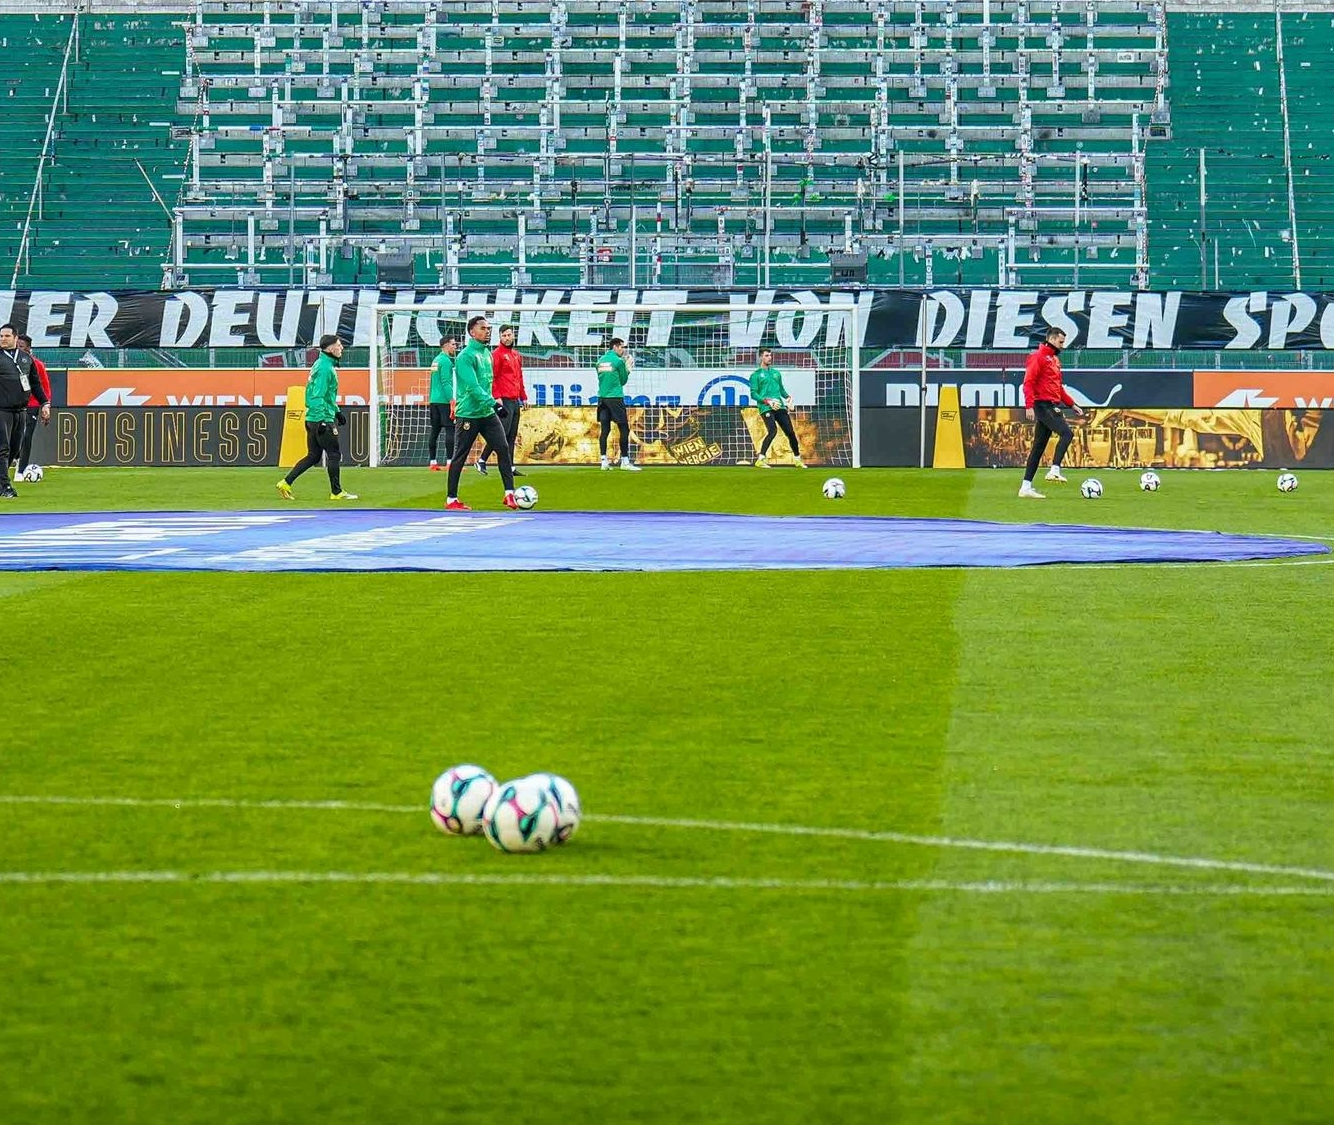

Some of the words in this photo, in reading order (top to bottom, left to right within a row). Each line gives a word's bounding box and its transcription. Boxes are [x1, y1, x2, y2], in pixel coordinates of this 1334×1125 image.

[159, 289, 689, 348] DEUTLICHKEIT
[726, 289, 875, 349] VON
[915, 289, 1183, 350] DIESEN
[57, 411, 267, 463] BUSINESS
[673, 439, 704, 456] WIEN
